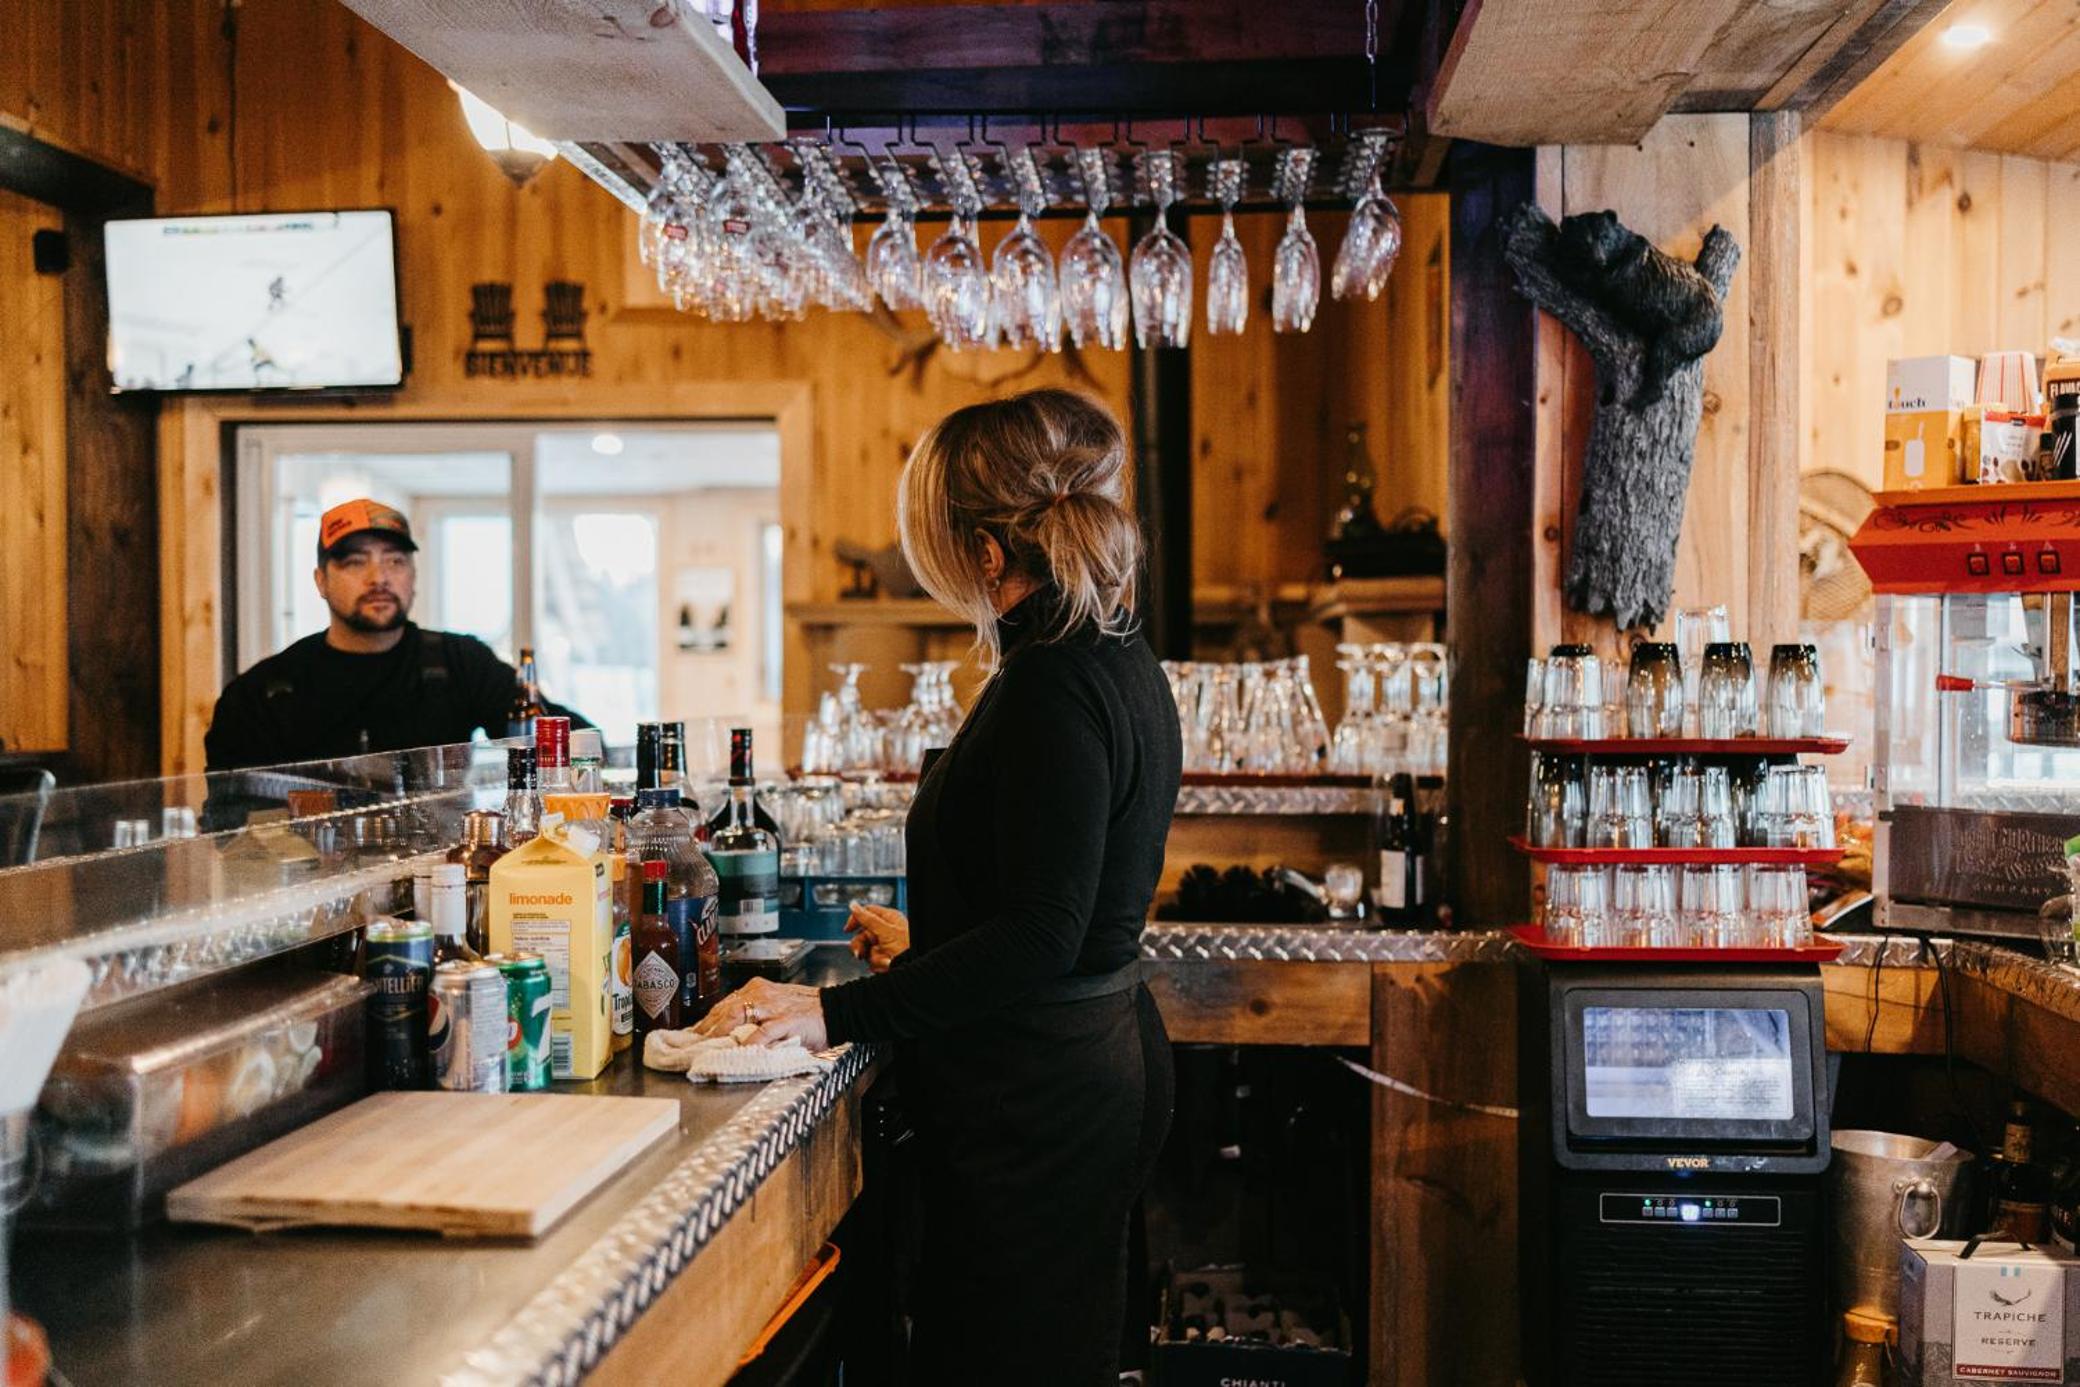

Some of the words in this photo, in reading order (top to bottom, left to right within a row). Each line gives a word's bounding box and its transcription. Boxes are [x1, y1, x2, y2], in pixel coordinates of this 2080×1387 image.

[509, 892, 573, 906] limonade
[1667, 1157, 1710, 1169] VEVOR
[1973, 1311, 2047, 1323] TRAPICHE
[1980, 1337, 2036, 1347] RESERVE
[1959, 1366, 2005, 1377] CABERNET
[2007, 1368, 2057, 1379] SAUVIGNON
